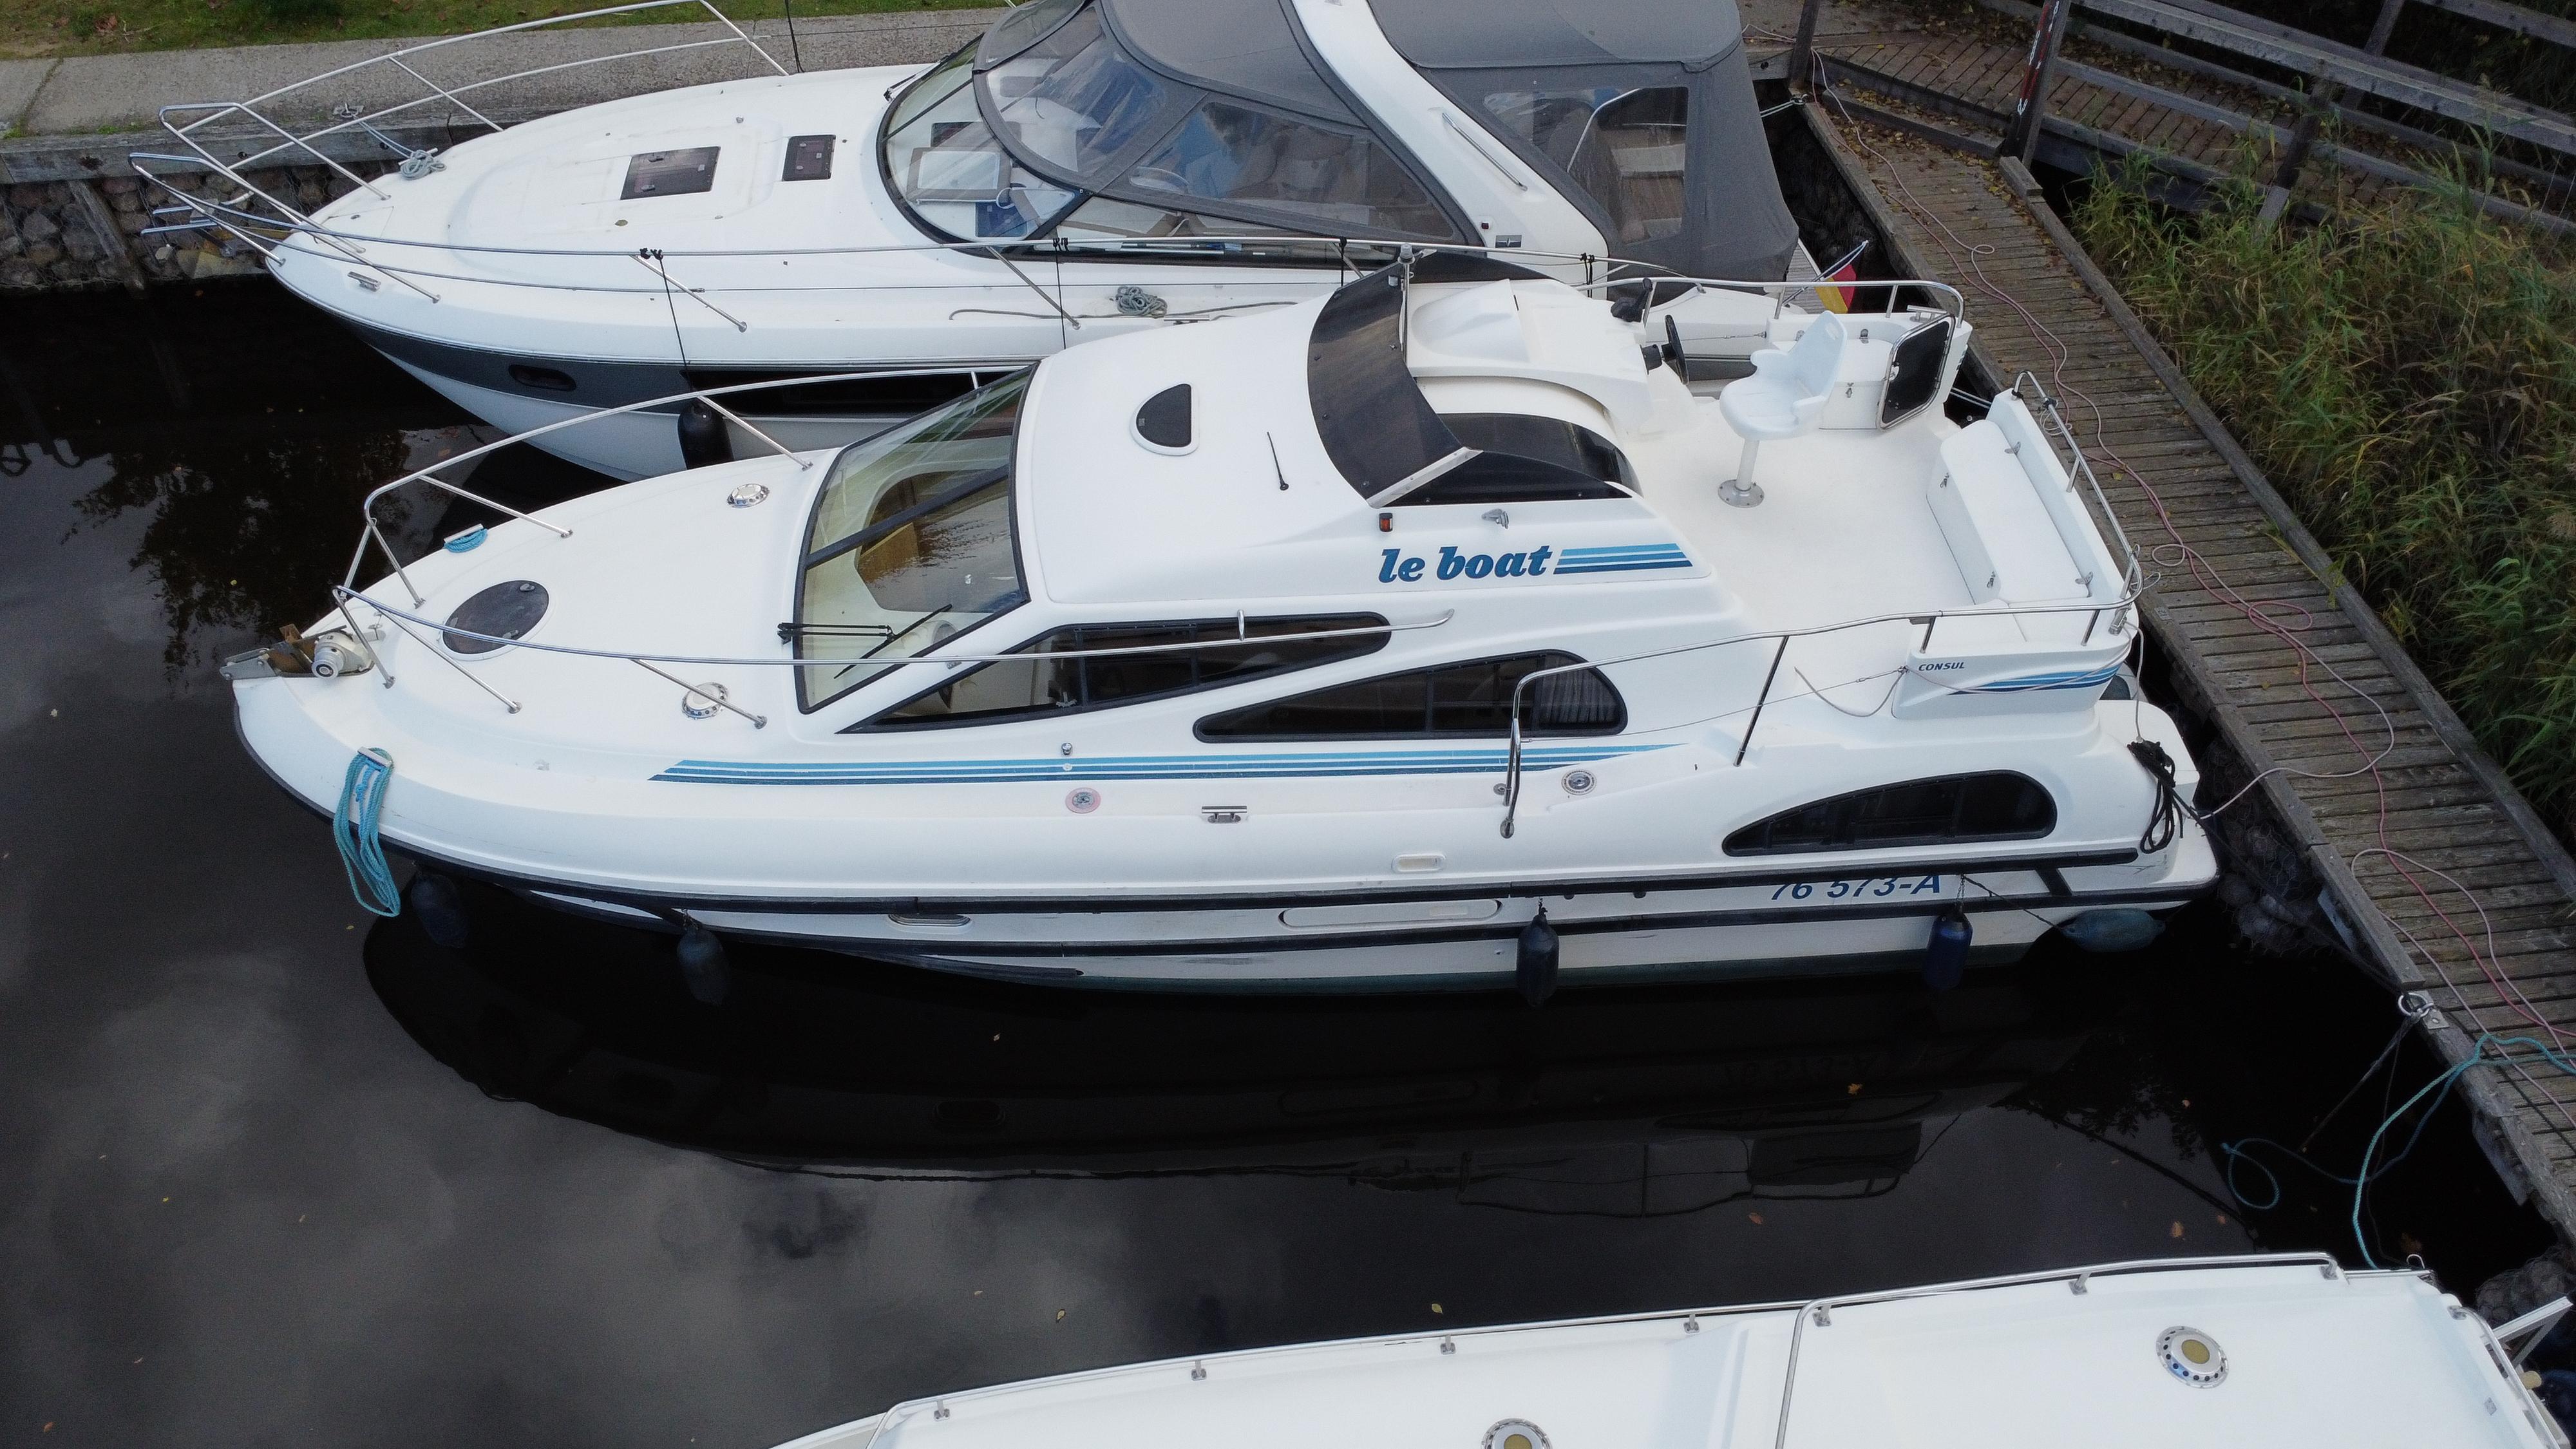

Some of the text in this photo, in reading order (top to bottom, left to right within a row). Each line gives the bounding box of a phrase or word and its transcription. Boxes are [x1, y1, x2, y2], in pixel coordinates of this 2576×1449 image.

[1378, 545, 1553, 583] le boat
[1918, 661, 1965, 672] CONSUL
